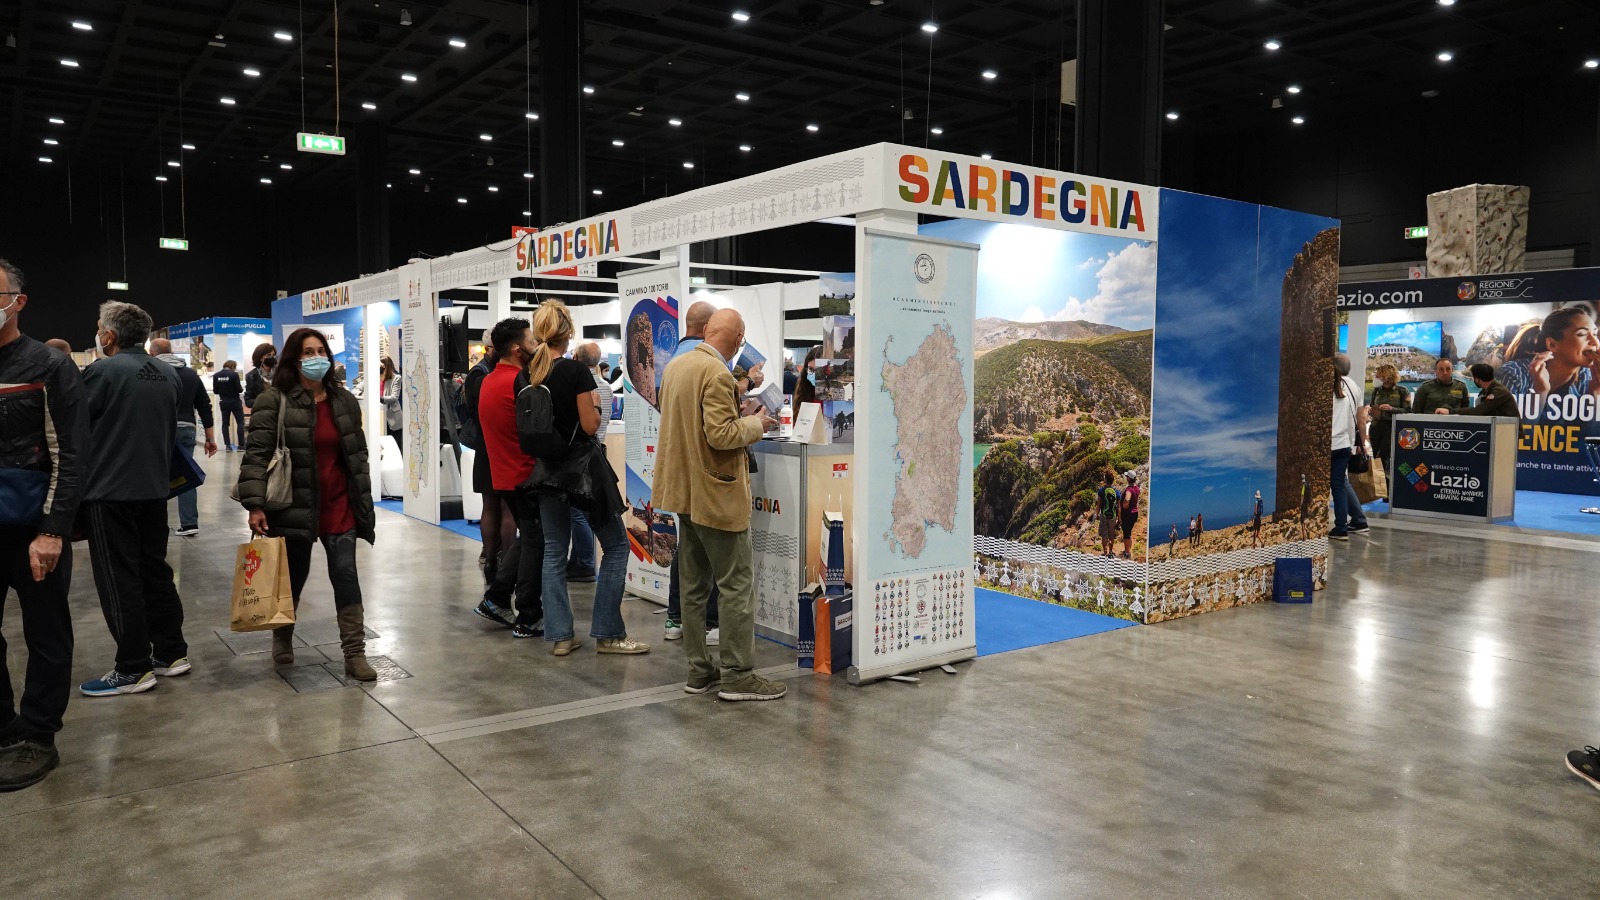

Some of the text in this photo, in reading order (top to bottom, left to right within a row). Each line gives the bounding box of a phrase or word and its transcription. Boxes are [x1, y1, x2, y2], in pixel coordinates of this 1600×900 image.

[898, 154, 1146, 232] SARDEGNA
[516, 218, 620, 271] SARDEGNA
[625, 282, 669, 296] CAMMINO 100 TORRI
[1479, 280, 1515, 289] REGIONE
[310, 285, 350, 311] SARDEGNA
[1478, 290, 1503, 298] LAZIO
[136, 373, 167, 381] adidas
[1512, 388, 1540, 420] IÙ
[1423, 430, 1465, 440] REGIONE
[1422, 441, 1451, 450] LAZIO
[1431, 464, 1470, 472] visitlazio.com
[1516, 461, 1539, 469] anche
[1554, 463, 1574, 471] tante
[1430, 471, 1481, 489] Lazio
[1433, 493, 1459, 502] EMBRACING
[1440, 488, 1484, 498] ETERNAL WONDERS
